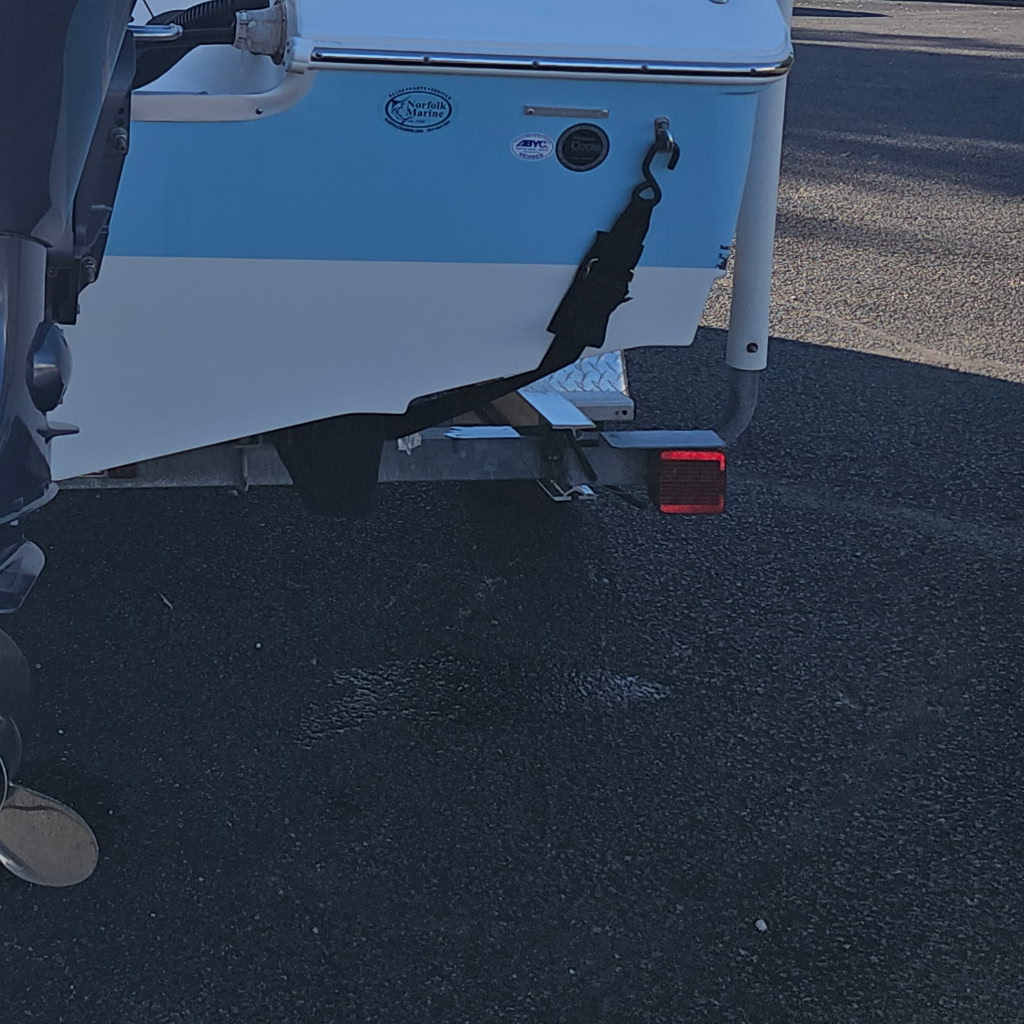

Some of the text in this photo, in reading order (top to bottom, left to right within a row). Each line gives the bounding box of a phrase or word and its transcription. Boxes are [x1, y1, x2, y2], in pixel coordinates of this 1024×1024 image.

[407, 100, 447, 110] Norfolk
[405, 108, 445, 118] Marine
[515, 139, 548, 148] ABYC
[519, 152, 544, 160] MEMBER
